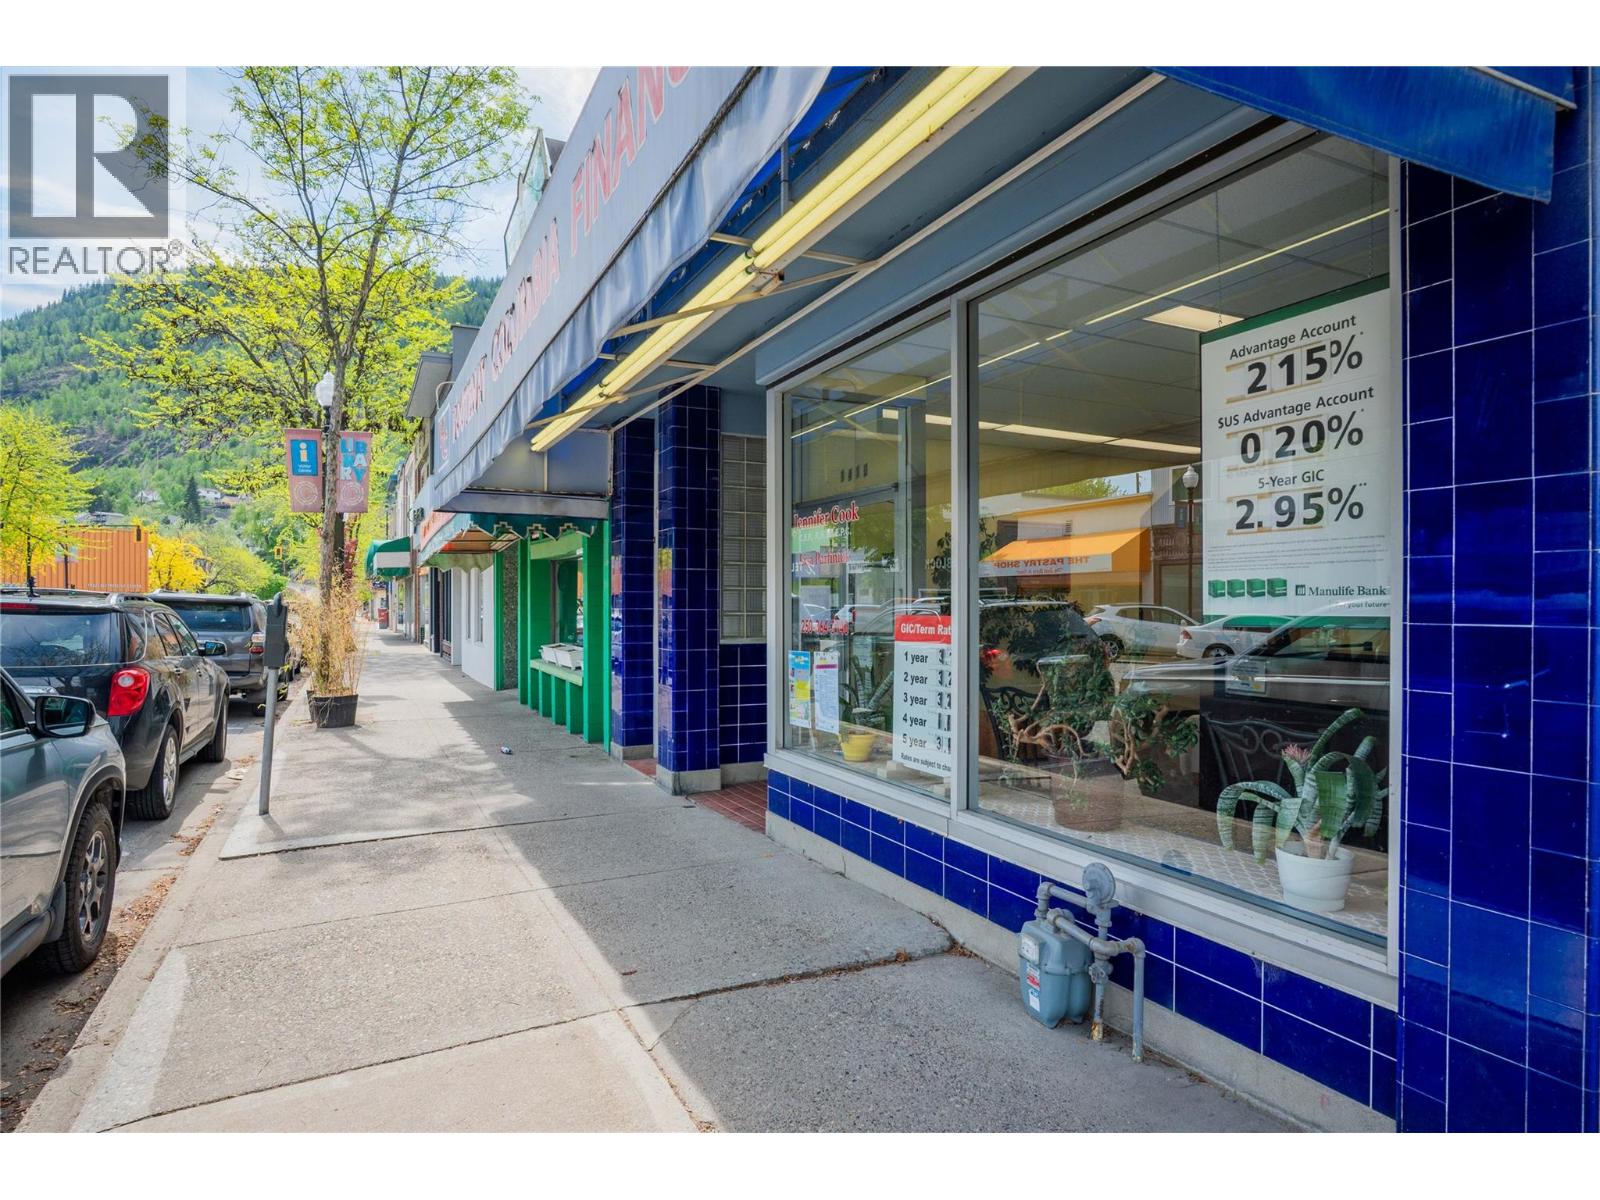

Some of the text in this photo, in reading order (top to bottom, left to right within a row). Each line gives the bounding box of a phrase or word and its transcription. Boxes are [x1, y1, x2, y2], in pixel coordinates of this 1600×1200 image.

[571, 66, 690, 257] FINAN
[1229, 315, 1357, 360] Advantage Account
[1243, 401, 1312, 424] Advantage
[1315, 386, 1375, 409] Account
[1257, 468, 1325, 489] 5-Year GIC
[793, 500, 860, 528] Jennifer Cook
[1308, 585, 1387, 596] Manulife Bank
[900, 623, 936, 635] GIC/Term
[904, 651, 908, 661] 1
[910, 654, 928, 664] year
[903, 671, 909, 682] 2
[910, 675, 928, 685] year
[903, 692, 908, 703] 3
[910, 696, 928, 706] year
[902, 713, 908, 723] 4
[909, 716, 927, 727] year
[902, 733, 908, 744] 5
[909, 737, 927, 748] year
[901, 752, 912, 761] Rates
[920, 760, 935, 769] subject
